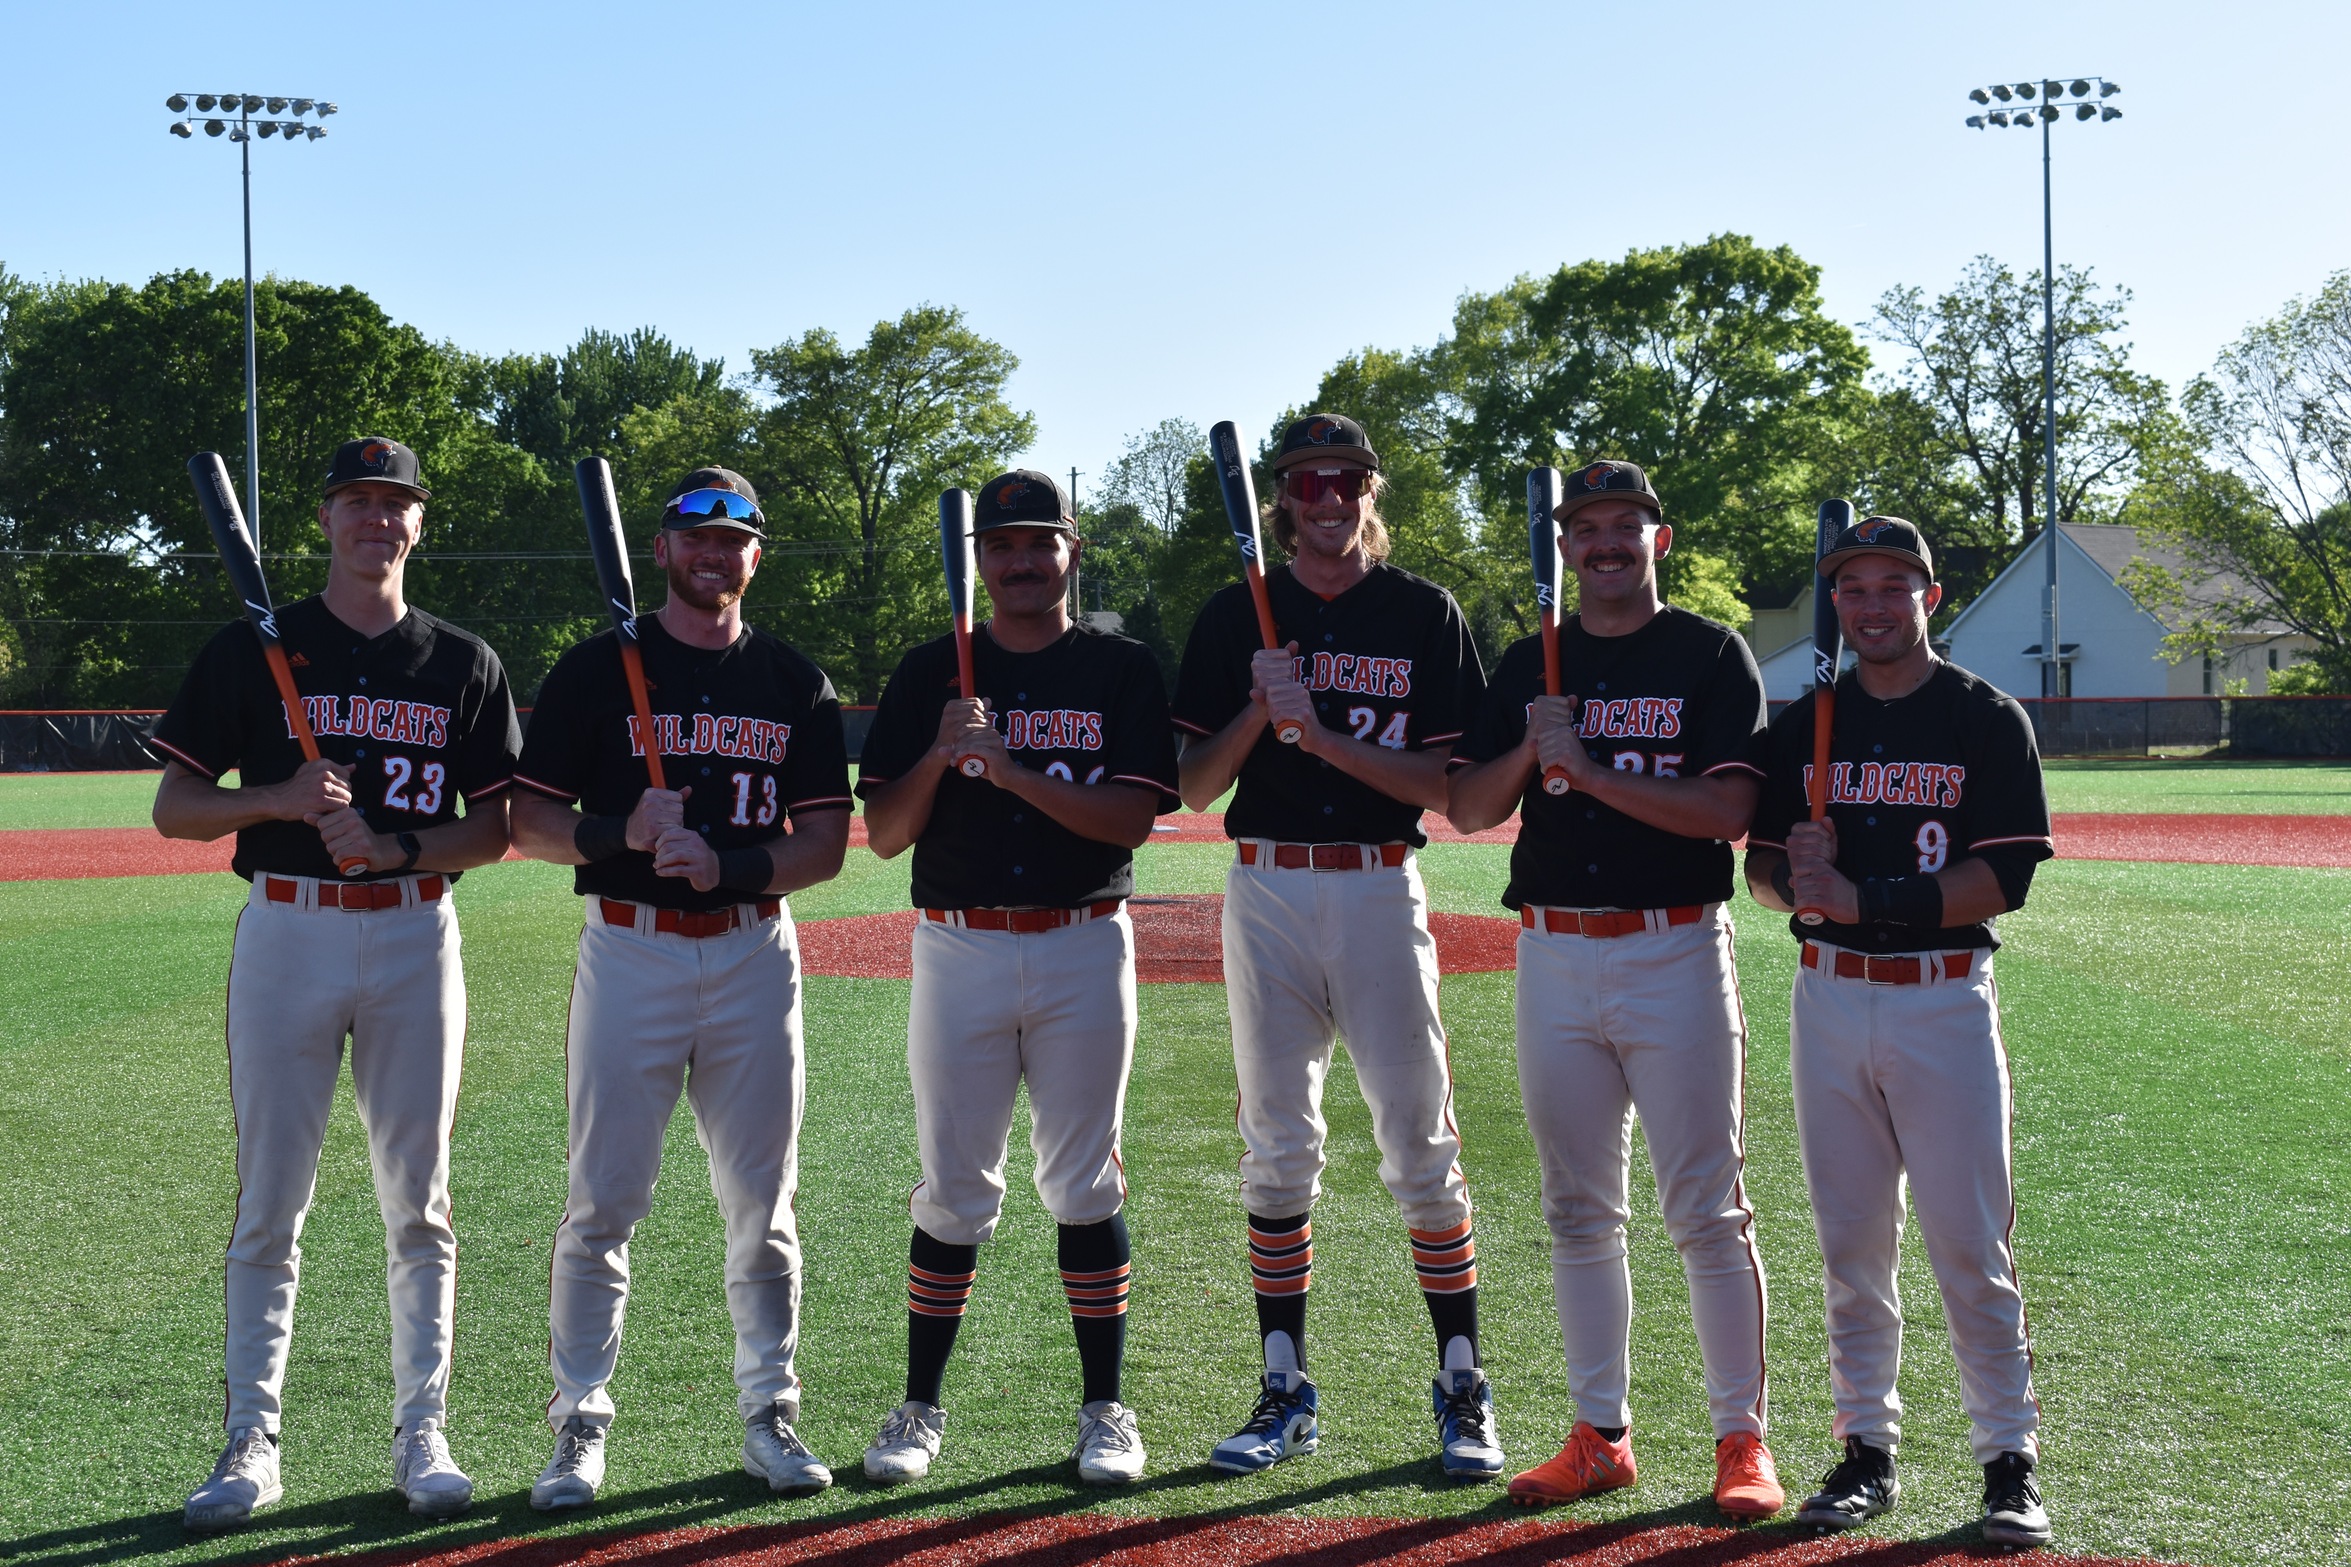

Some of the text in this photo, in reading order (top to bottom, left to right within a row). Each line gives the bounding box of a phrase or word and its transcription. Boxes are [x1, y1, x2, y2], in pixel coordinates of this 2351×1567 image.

[1293, 651, 1413, 698] LDCATS
[281, 695, 452, 749] WILDCATS
[626, 713, 792, 765] WILDCATS
[987, 709, 1103, 750] DCATS
[1348, 706, 1411, 750] 24
[1526, 697, 1684, 739] DCATS
[382, 755, 446, 816] 23
[729, 771, 779, 828] 13
[1803, 762, 1966, 809] WILDCATS
[1912, 819, 1951, 874] 9
